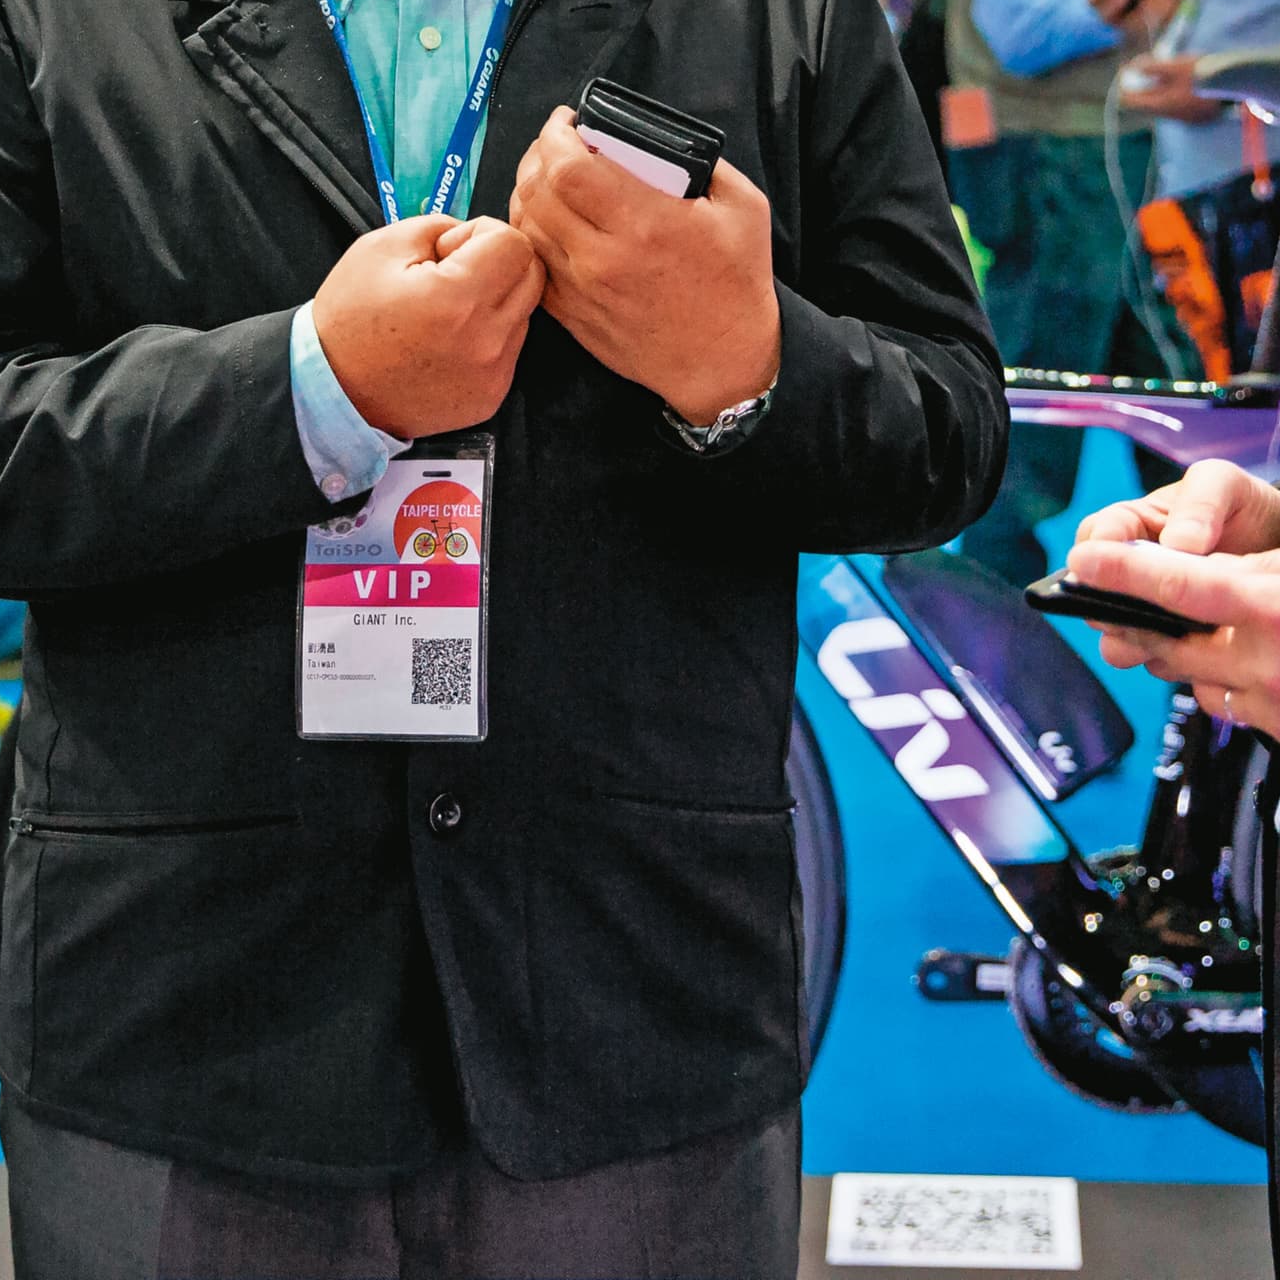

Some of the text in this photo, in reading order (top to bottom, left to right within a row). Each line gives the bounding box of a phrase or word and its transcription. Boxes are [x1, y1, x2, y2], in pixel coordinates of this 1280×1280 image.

[471, 60, 494, 112] GIANT
[402, 504, 482, 518] TAIPEI CYCLE
[314, 543, 383, 557] TaiSPO
[353, 570, 431, 599] VIP
[353, 613, 417, 626] GIANT Inc.
